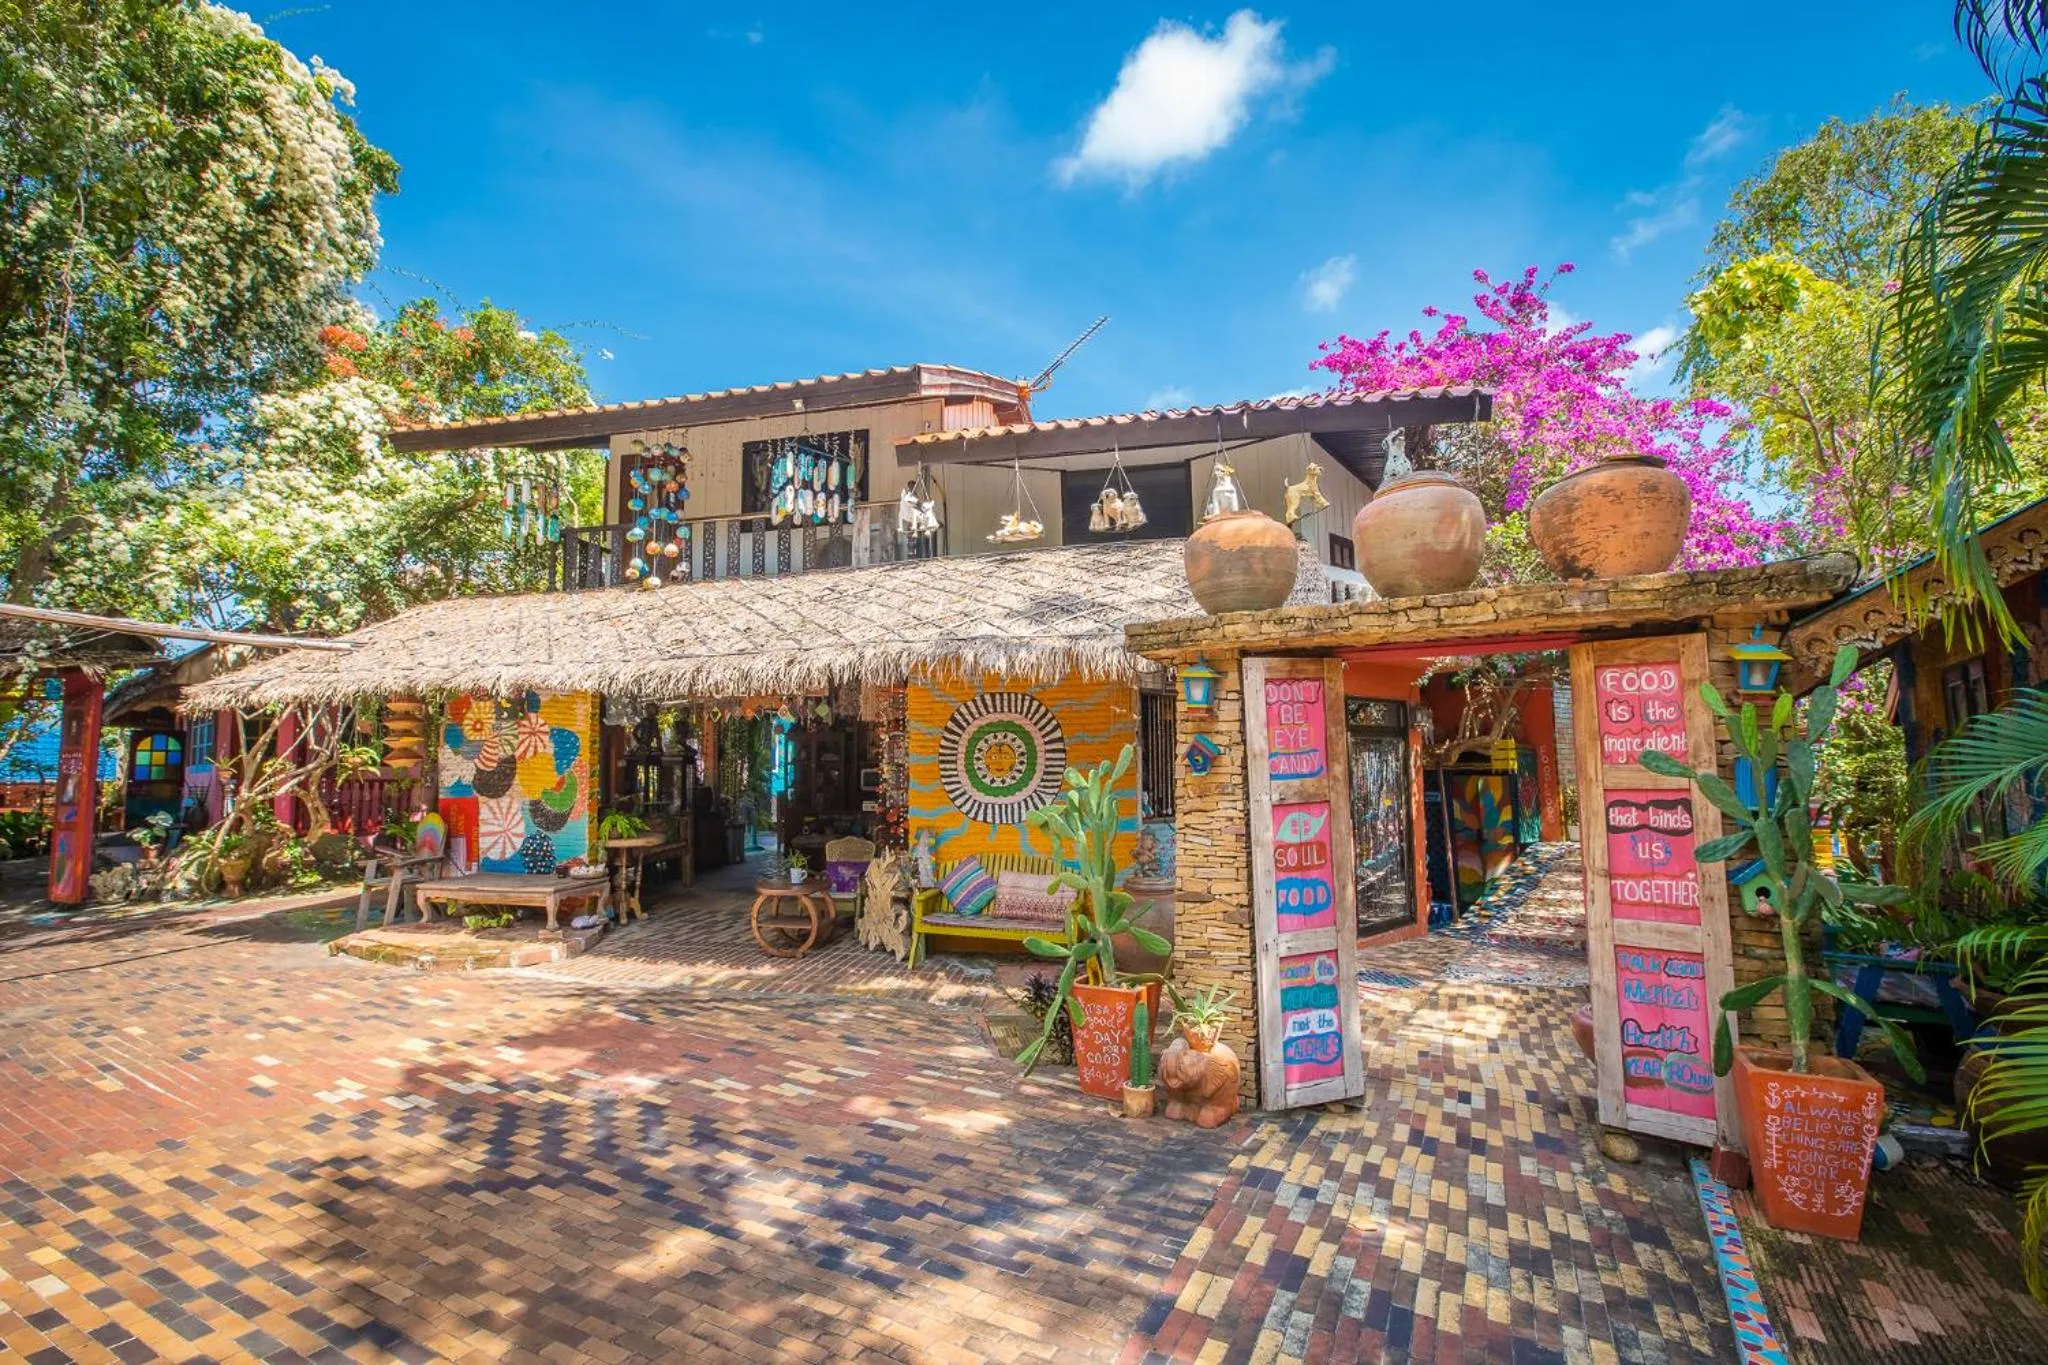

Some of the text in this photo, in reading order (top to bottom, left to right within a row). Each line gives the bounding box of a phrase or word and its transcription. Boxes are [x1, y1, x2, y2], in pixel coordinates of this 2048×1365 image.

[1606, 670, 1676, 692] FOOD
[1265, 680, 1320, 705] DON'T
[1280, 703, 1306, 725] BE
[1646, 701, 1677, 721] the
[1274, 727, 1309, 749] EYE
[1603, 730, 1688, 763] ingredient
[1269, 751, 1321, 775] CANDY
[1290, 818, 1311, 836] BE
[1609, 805, 1692, 829] that binds
[1274, 843, 1326, 868] SOUL
[1278, 885, 1328, 908] FOOD
[1611, 878, 1700, 908] TOGETHER
[1292, 1012, 1335, 1033] not the
[1093, 1030, 1121, 1044] DAY
